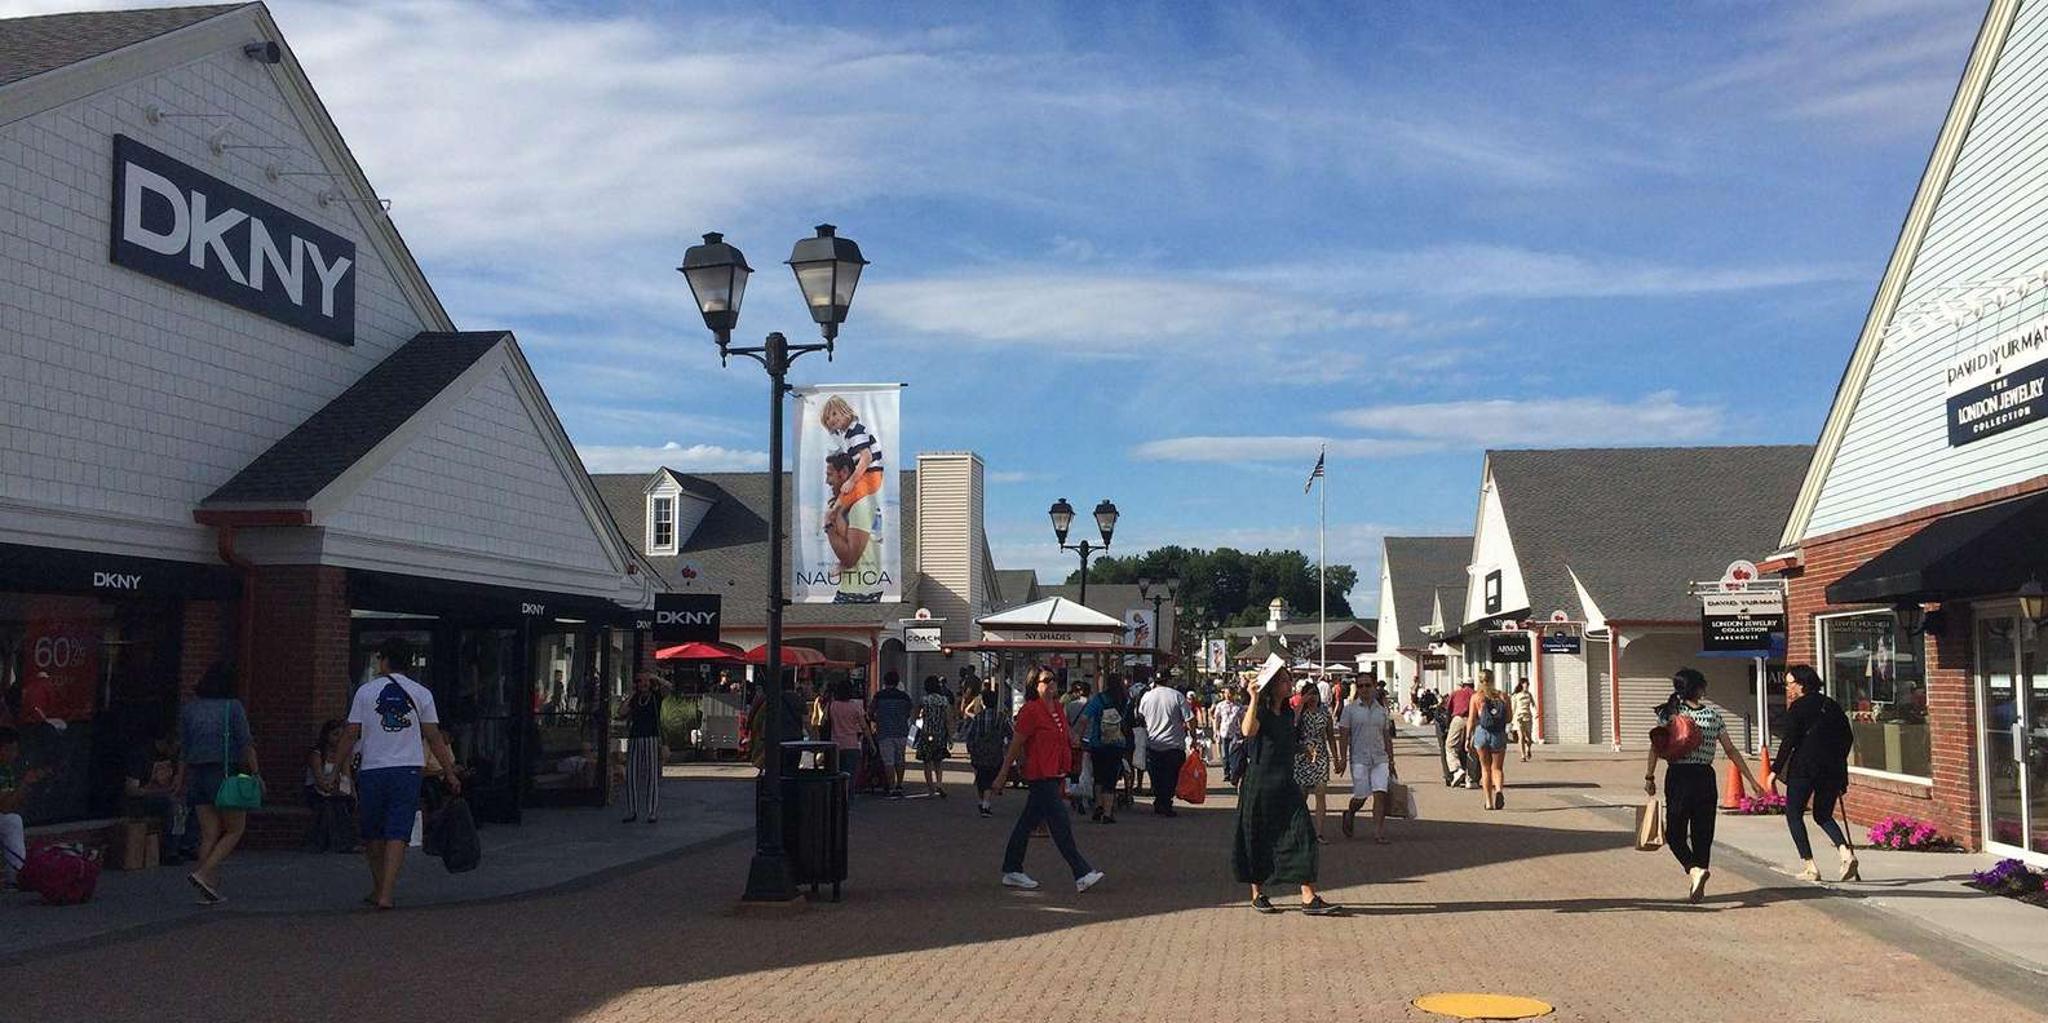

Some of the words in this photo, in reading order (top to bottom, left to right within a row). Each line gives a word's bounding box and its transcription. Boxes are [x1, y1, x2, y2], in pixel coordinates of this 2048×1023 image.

[123, 160, 353, 319] DKNY
[1947, 353, 1988, 384] DAVID
[1990, 378, 2008, 392] THE
[1958, 394, 1999, 425] LONDON
[1998, 377, 2045, 410] JEWELRY
[1973, 406, 2031, 434] COLLECTION
[93, 572, 142, 590] DKNY
[796, 570, 892, 586] NAUTICA
[521, 602, 545, 616] DKNY
[656, 611, 717, 625] DKNY
[1025, 632, 1037, 640] NY
[1039, 632, 1071, 640] SHADES
